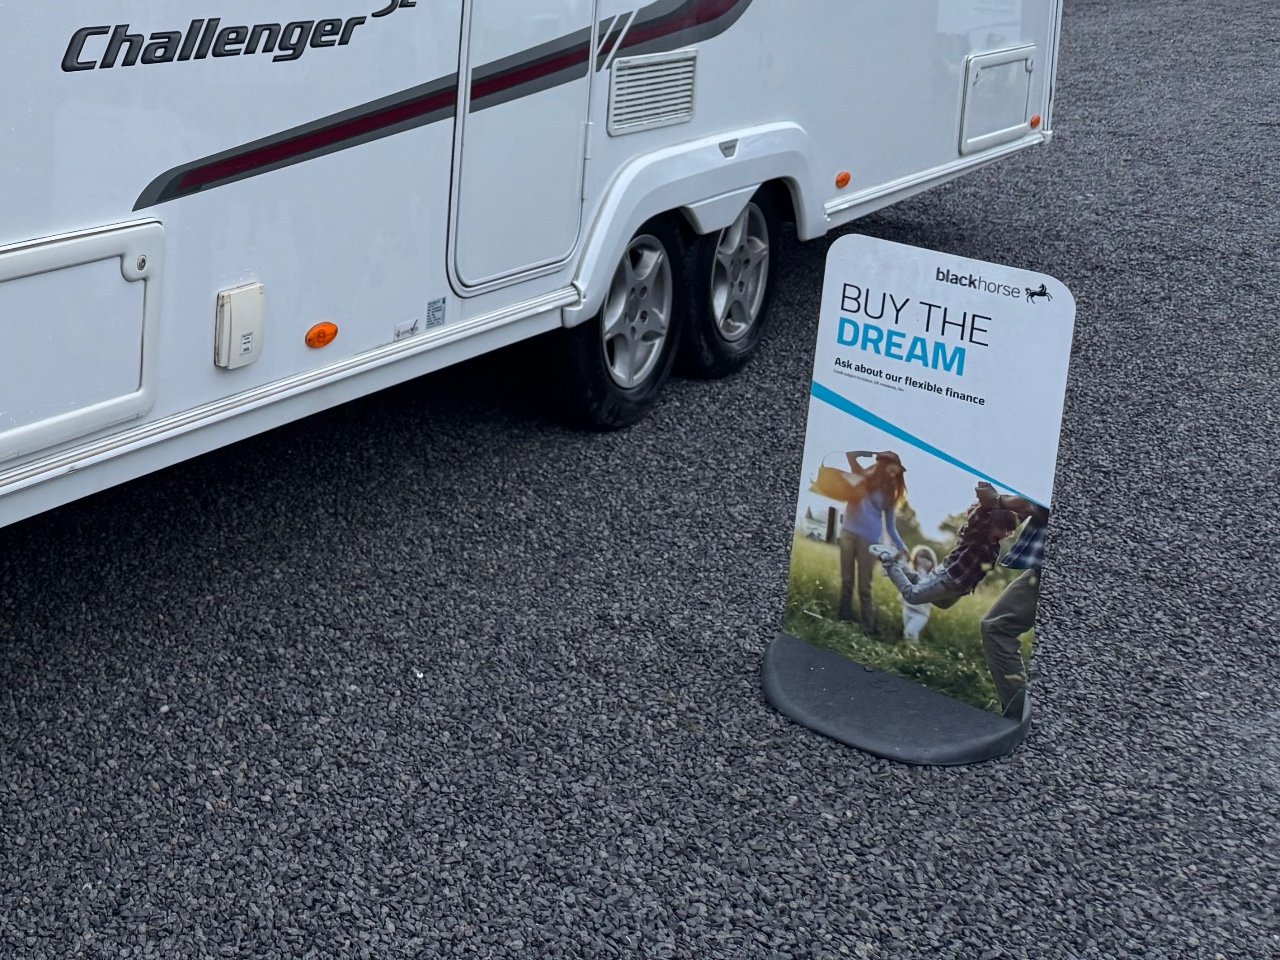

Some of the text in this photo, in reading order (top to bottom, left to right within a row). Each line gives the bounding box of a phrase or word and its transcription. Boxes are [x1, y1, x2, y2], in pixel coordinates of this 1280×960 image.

[61, 17, 367, 73] Challenger
[935, 266, 1021, 299] blackhorse
[840, 282, 992, 347] BUY THE
[836, 316, 967, 377] DREAM
[834, 357, 986, 406] Ask about our flexible finance
